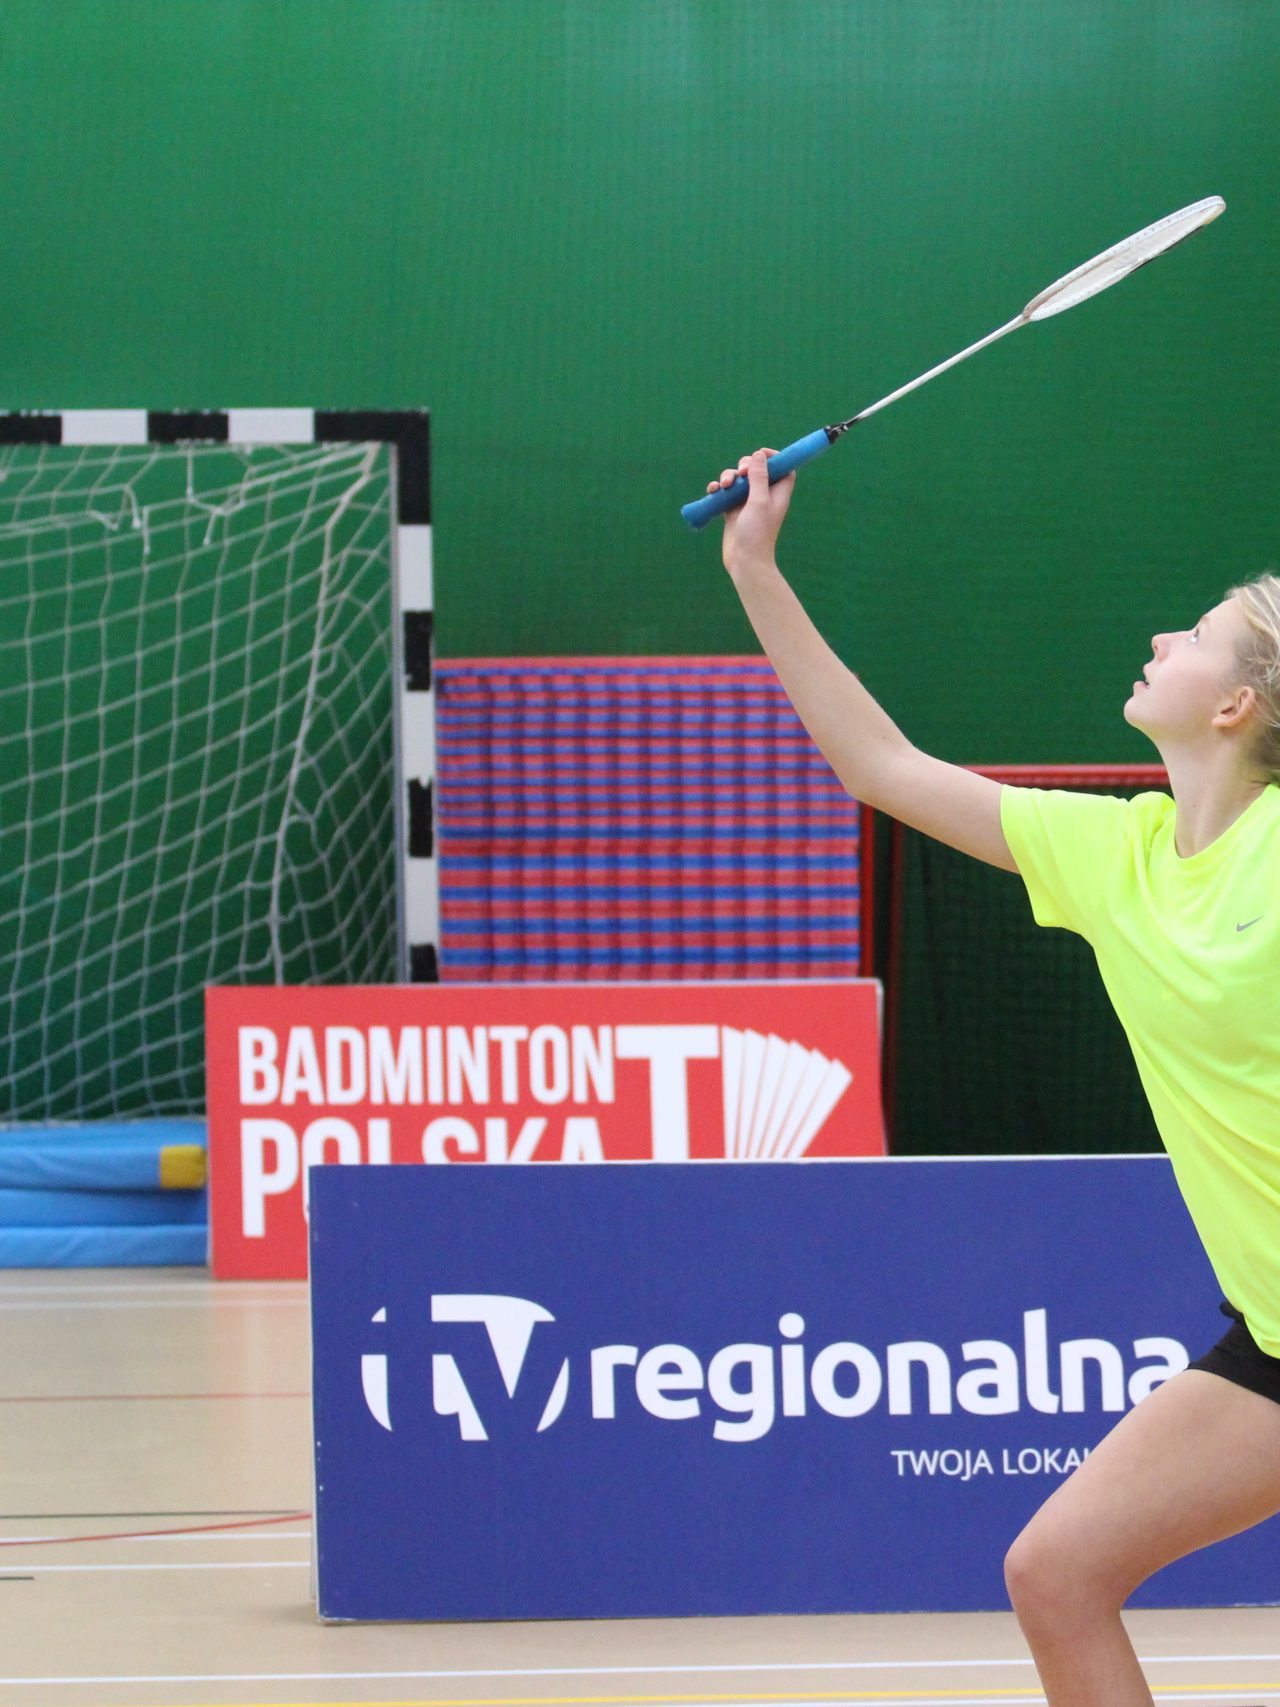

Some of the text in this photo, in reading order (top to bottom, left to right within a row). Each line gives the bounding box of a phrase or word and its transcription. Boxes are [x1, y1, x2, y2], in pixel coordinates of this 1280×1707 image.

[238, 1025, 615, 1105] BADMINTON
[590, 1309, 1190, 1442] regionalna
[890, 1450, 994, 1481] TWOJA
